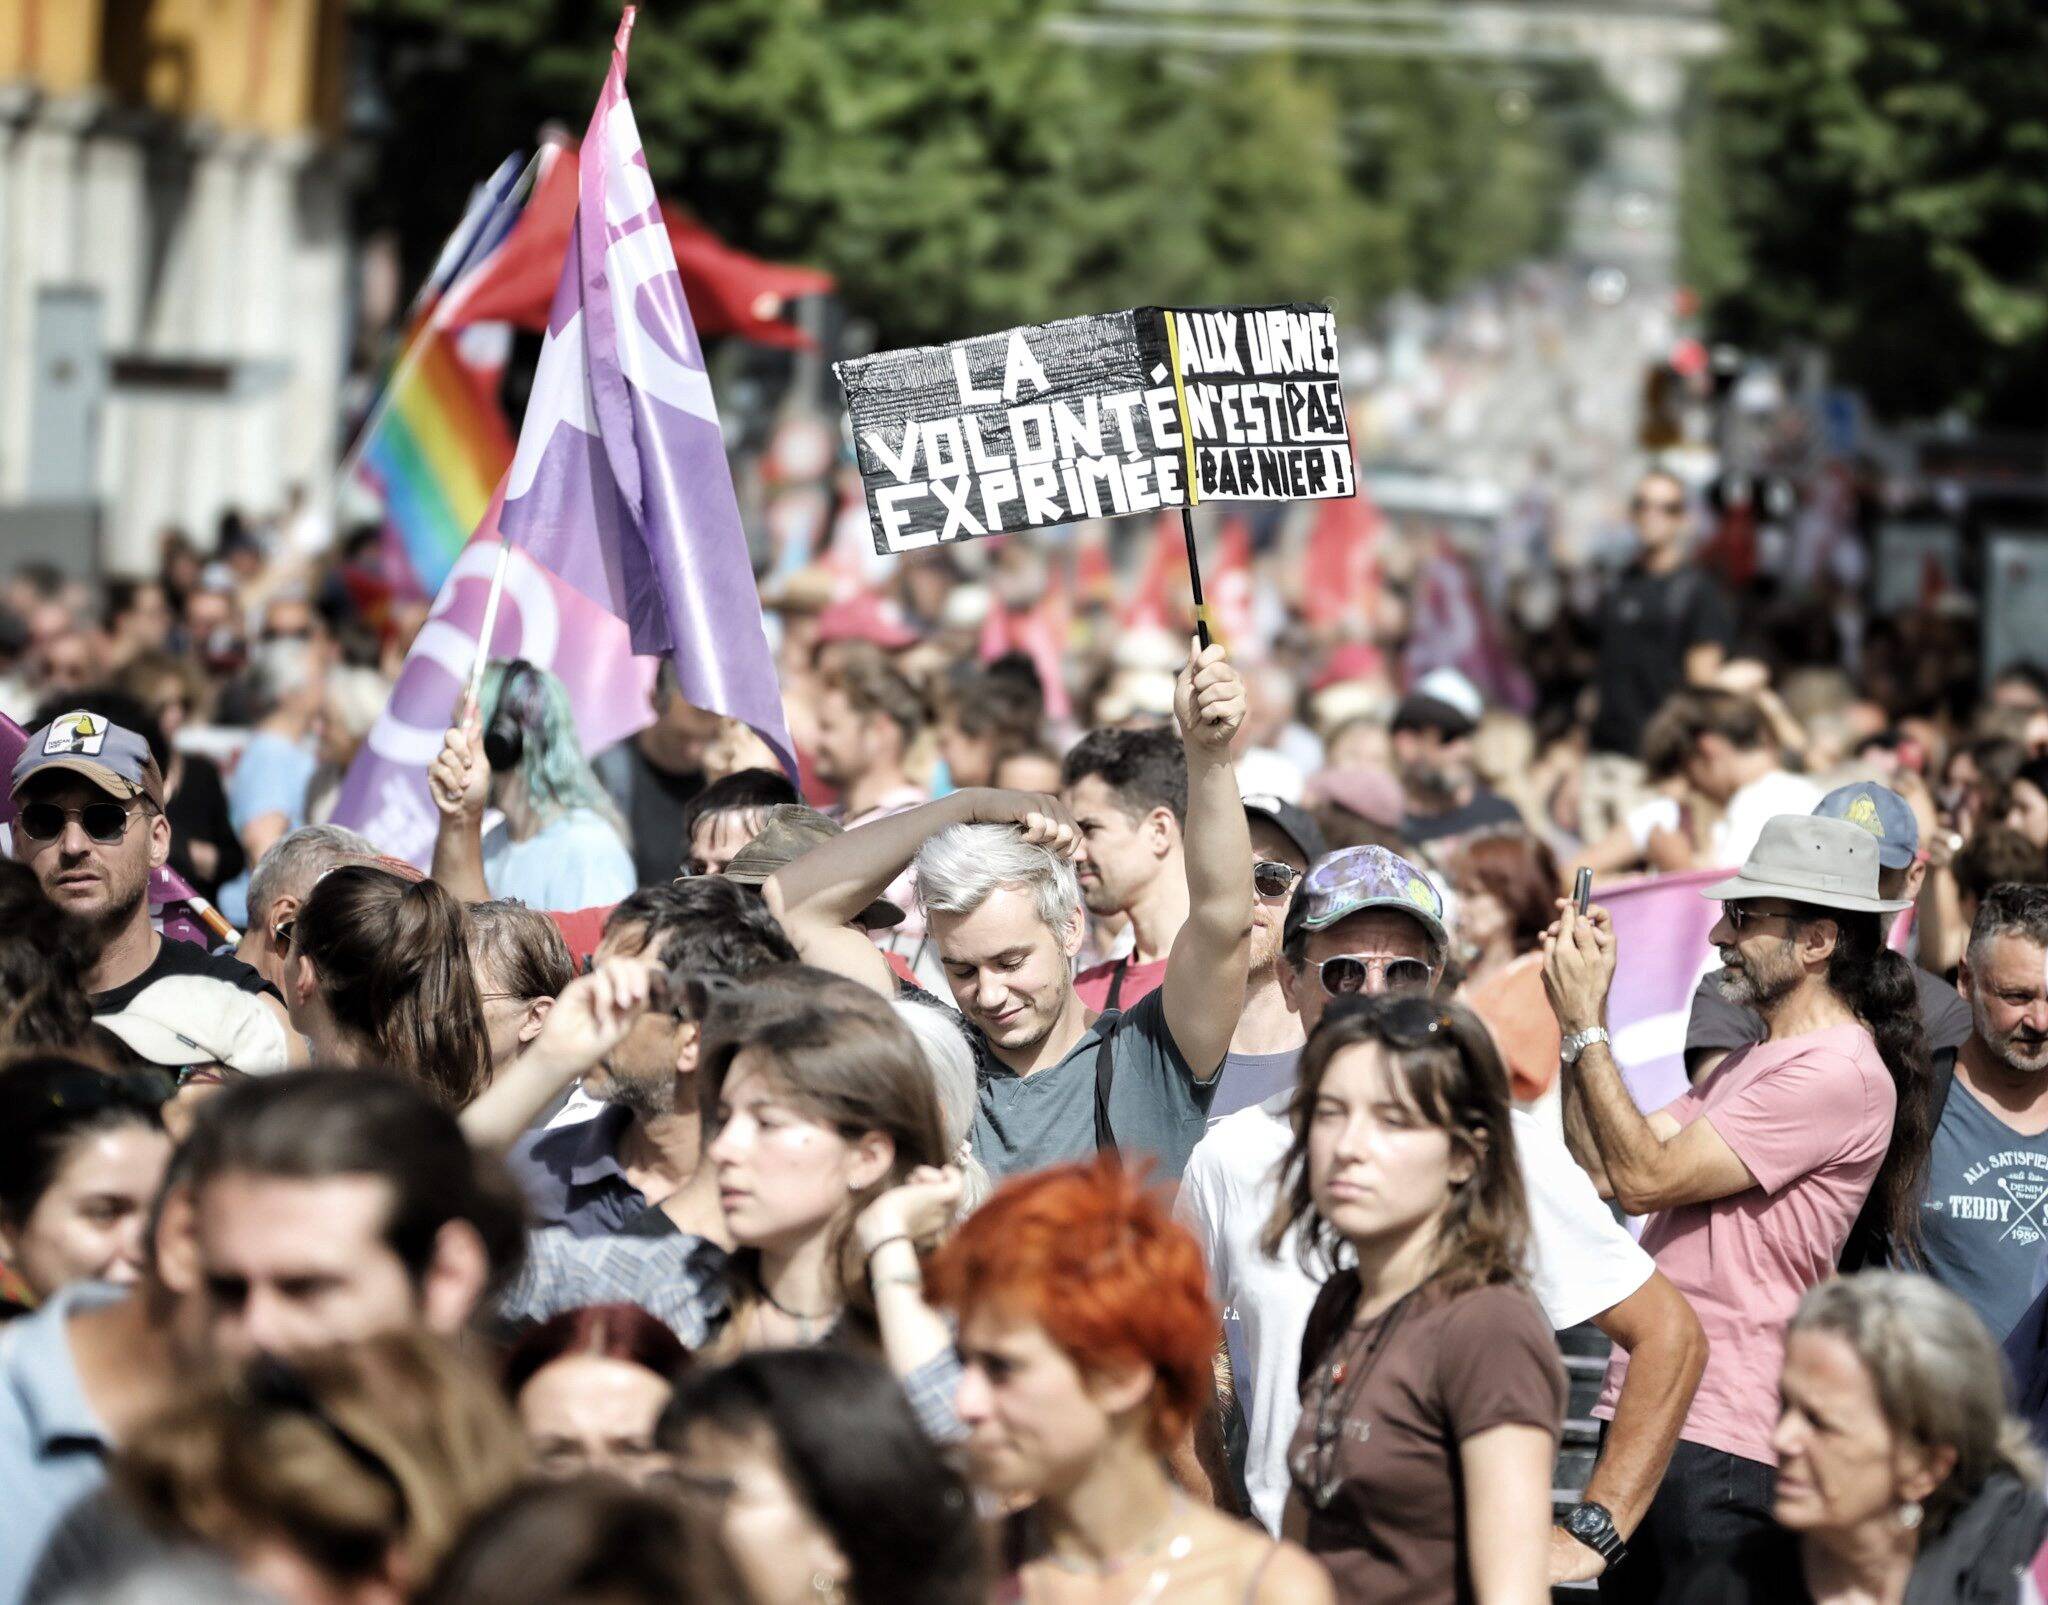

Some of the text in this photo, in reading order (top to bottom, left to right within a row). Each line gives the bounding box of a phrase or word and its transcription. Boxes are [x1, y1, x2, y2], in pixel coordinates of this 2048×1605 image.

[951, 330, 1051, 405] LA
[1176, 310, 1339, 376] AUX URNES
[864, 362, 1183, 484] VOLONTÉ
[1184, 382, 1345, 443] N'EST PAS
[1962, 1161, 1990, 1186] ALL
[2010, 1182, 2043, 1193] DENIM
[1949, 1195, 2011, 1222] TEDDY
